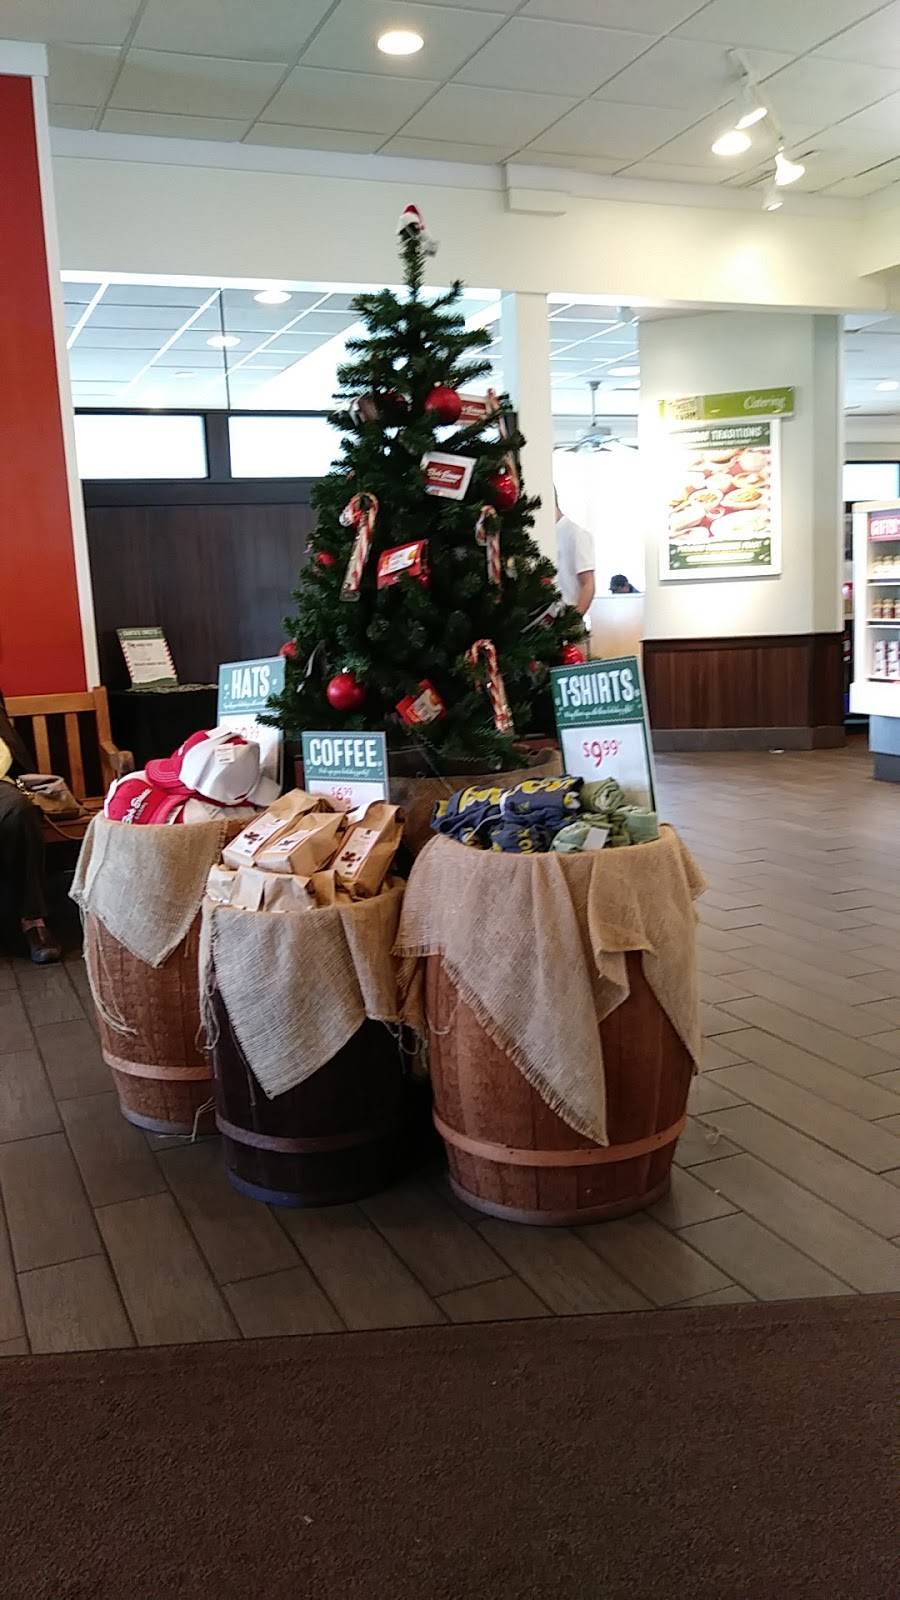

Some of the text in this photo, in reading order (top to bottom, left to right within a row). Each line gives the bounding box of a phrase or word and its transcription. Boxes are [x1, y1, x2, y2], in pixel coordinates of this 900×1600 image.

[744, 396, 786, 410] Catering
[231, 664, 271, 699] HATS
[557, 668, 635, 708] T-SHIRTS
[309, 738, 377, 767] COFFEE
